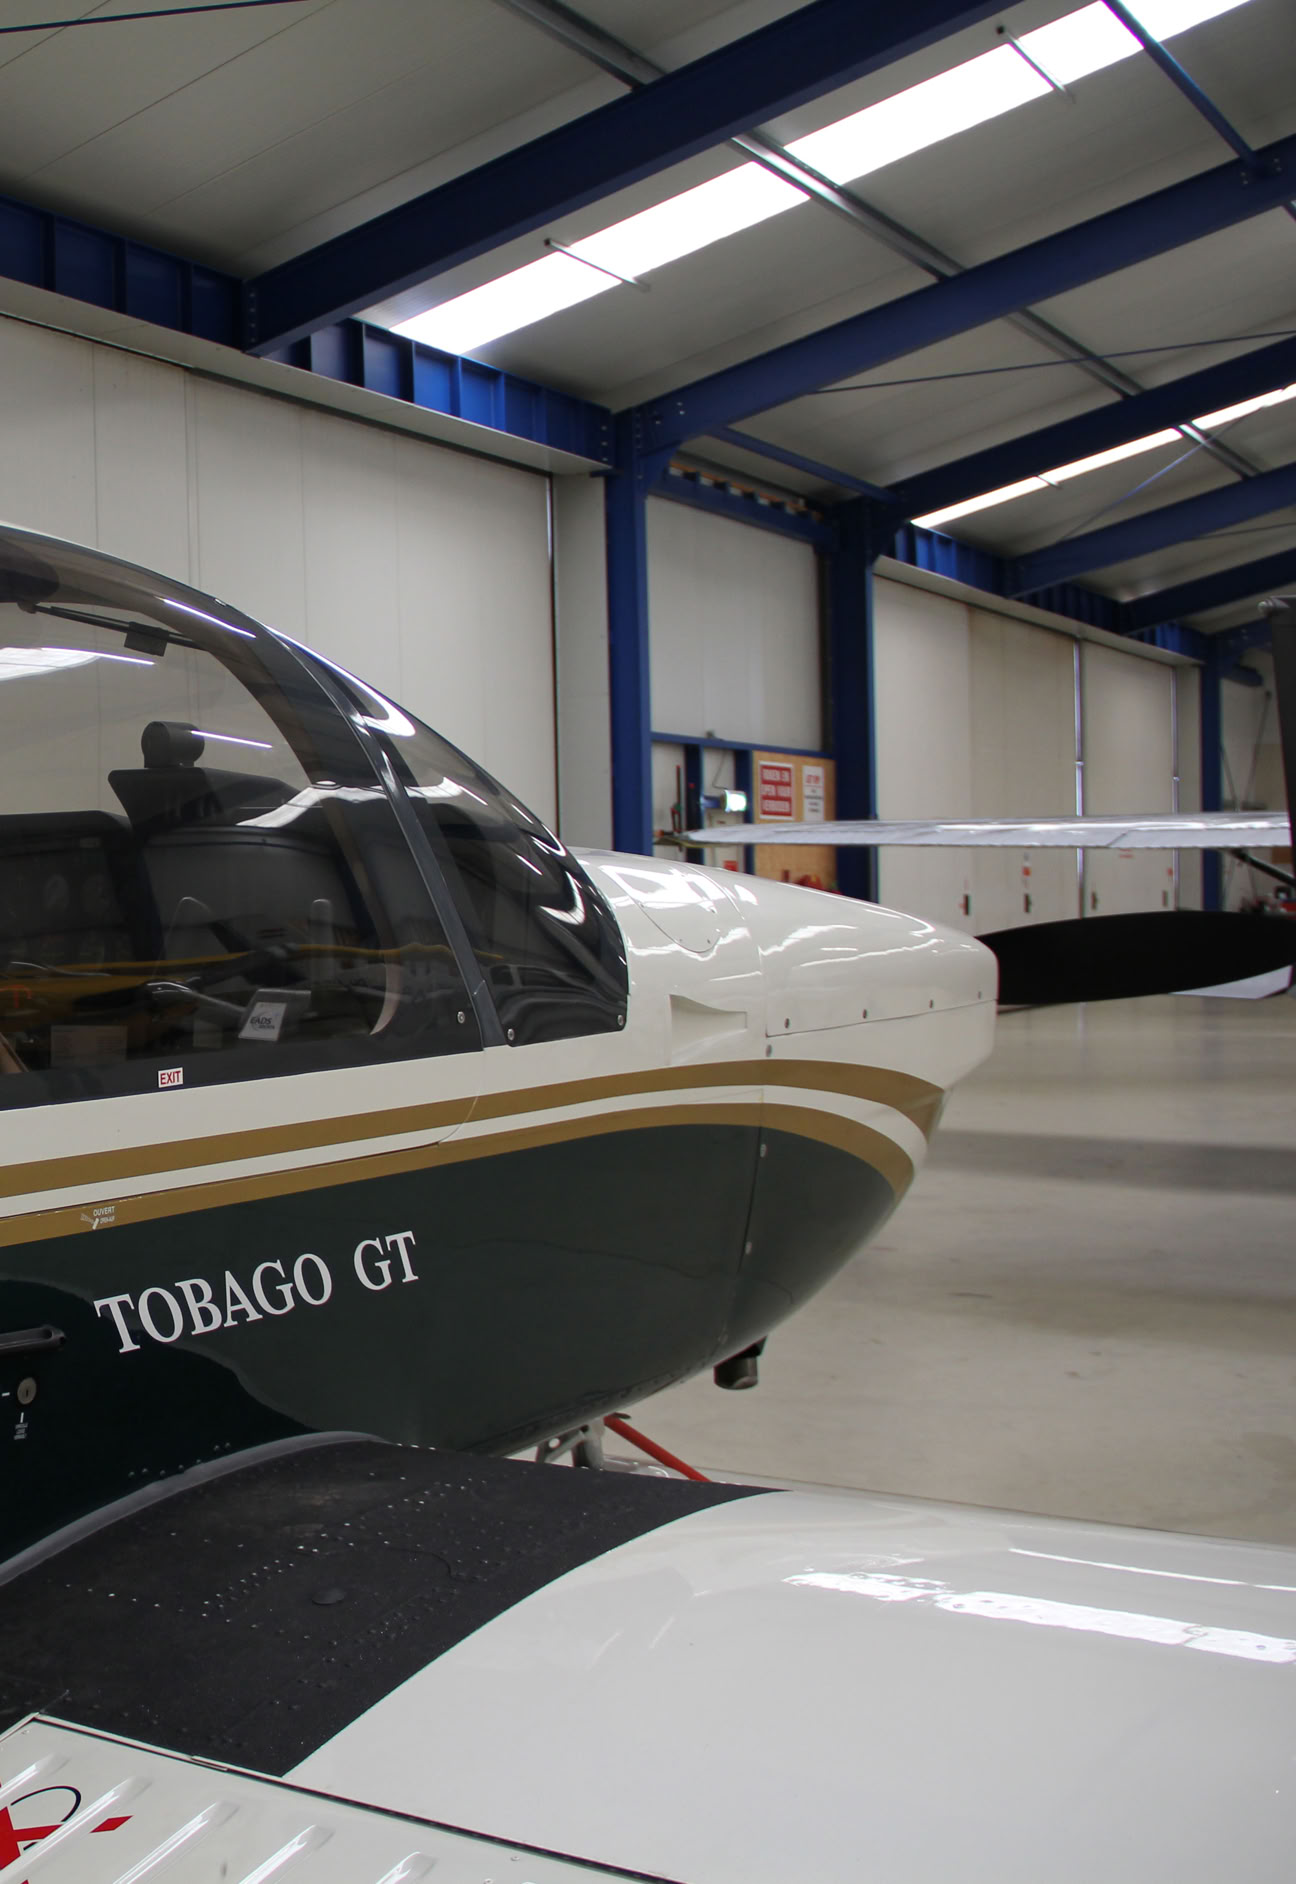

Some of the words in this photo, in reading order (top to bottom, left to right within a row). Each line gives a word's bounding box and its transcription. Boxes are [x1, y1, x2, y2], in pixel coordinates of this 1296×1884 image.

[160, 1070, 181, 1085] EXIT
[93, 1206, 115, 1217] OUVERT
[93, 1253, 332, 1353] TOBAGO
[354, 1231, 419, 1291] GT
